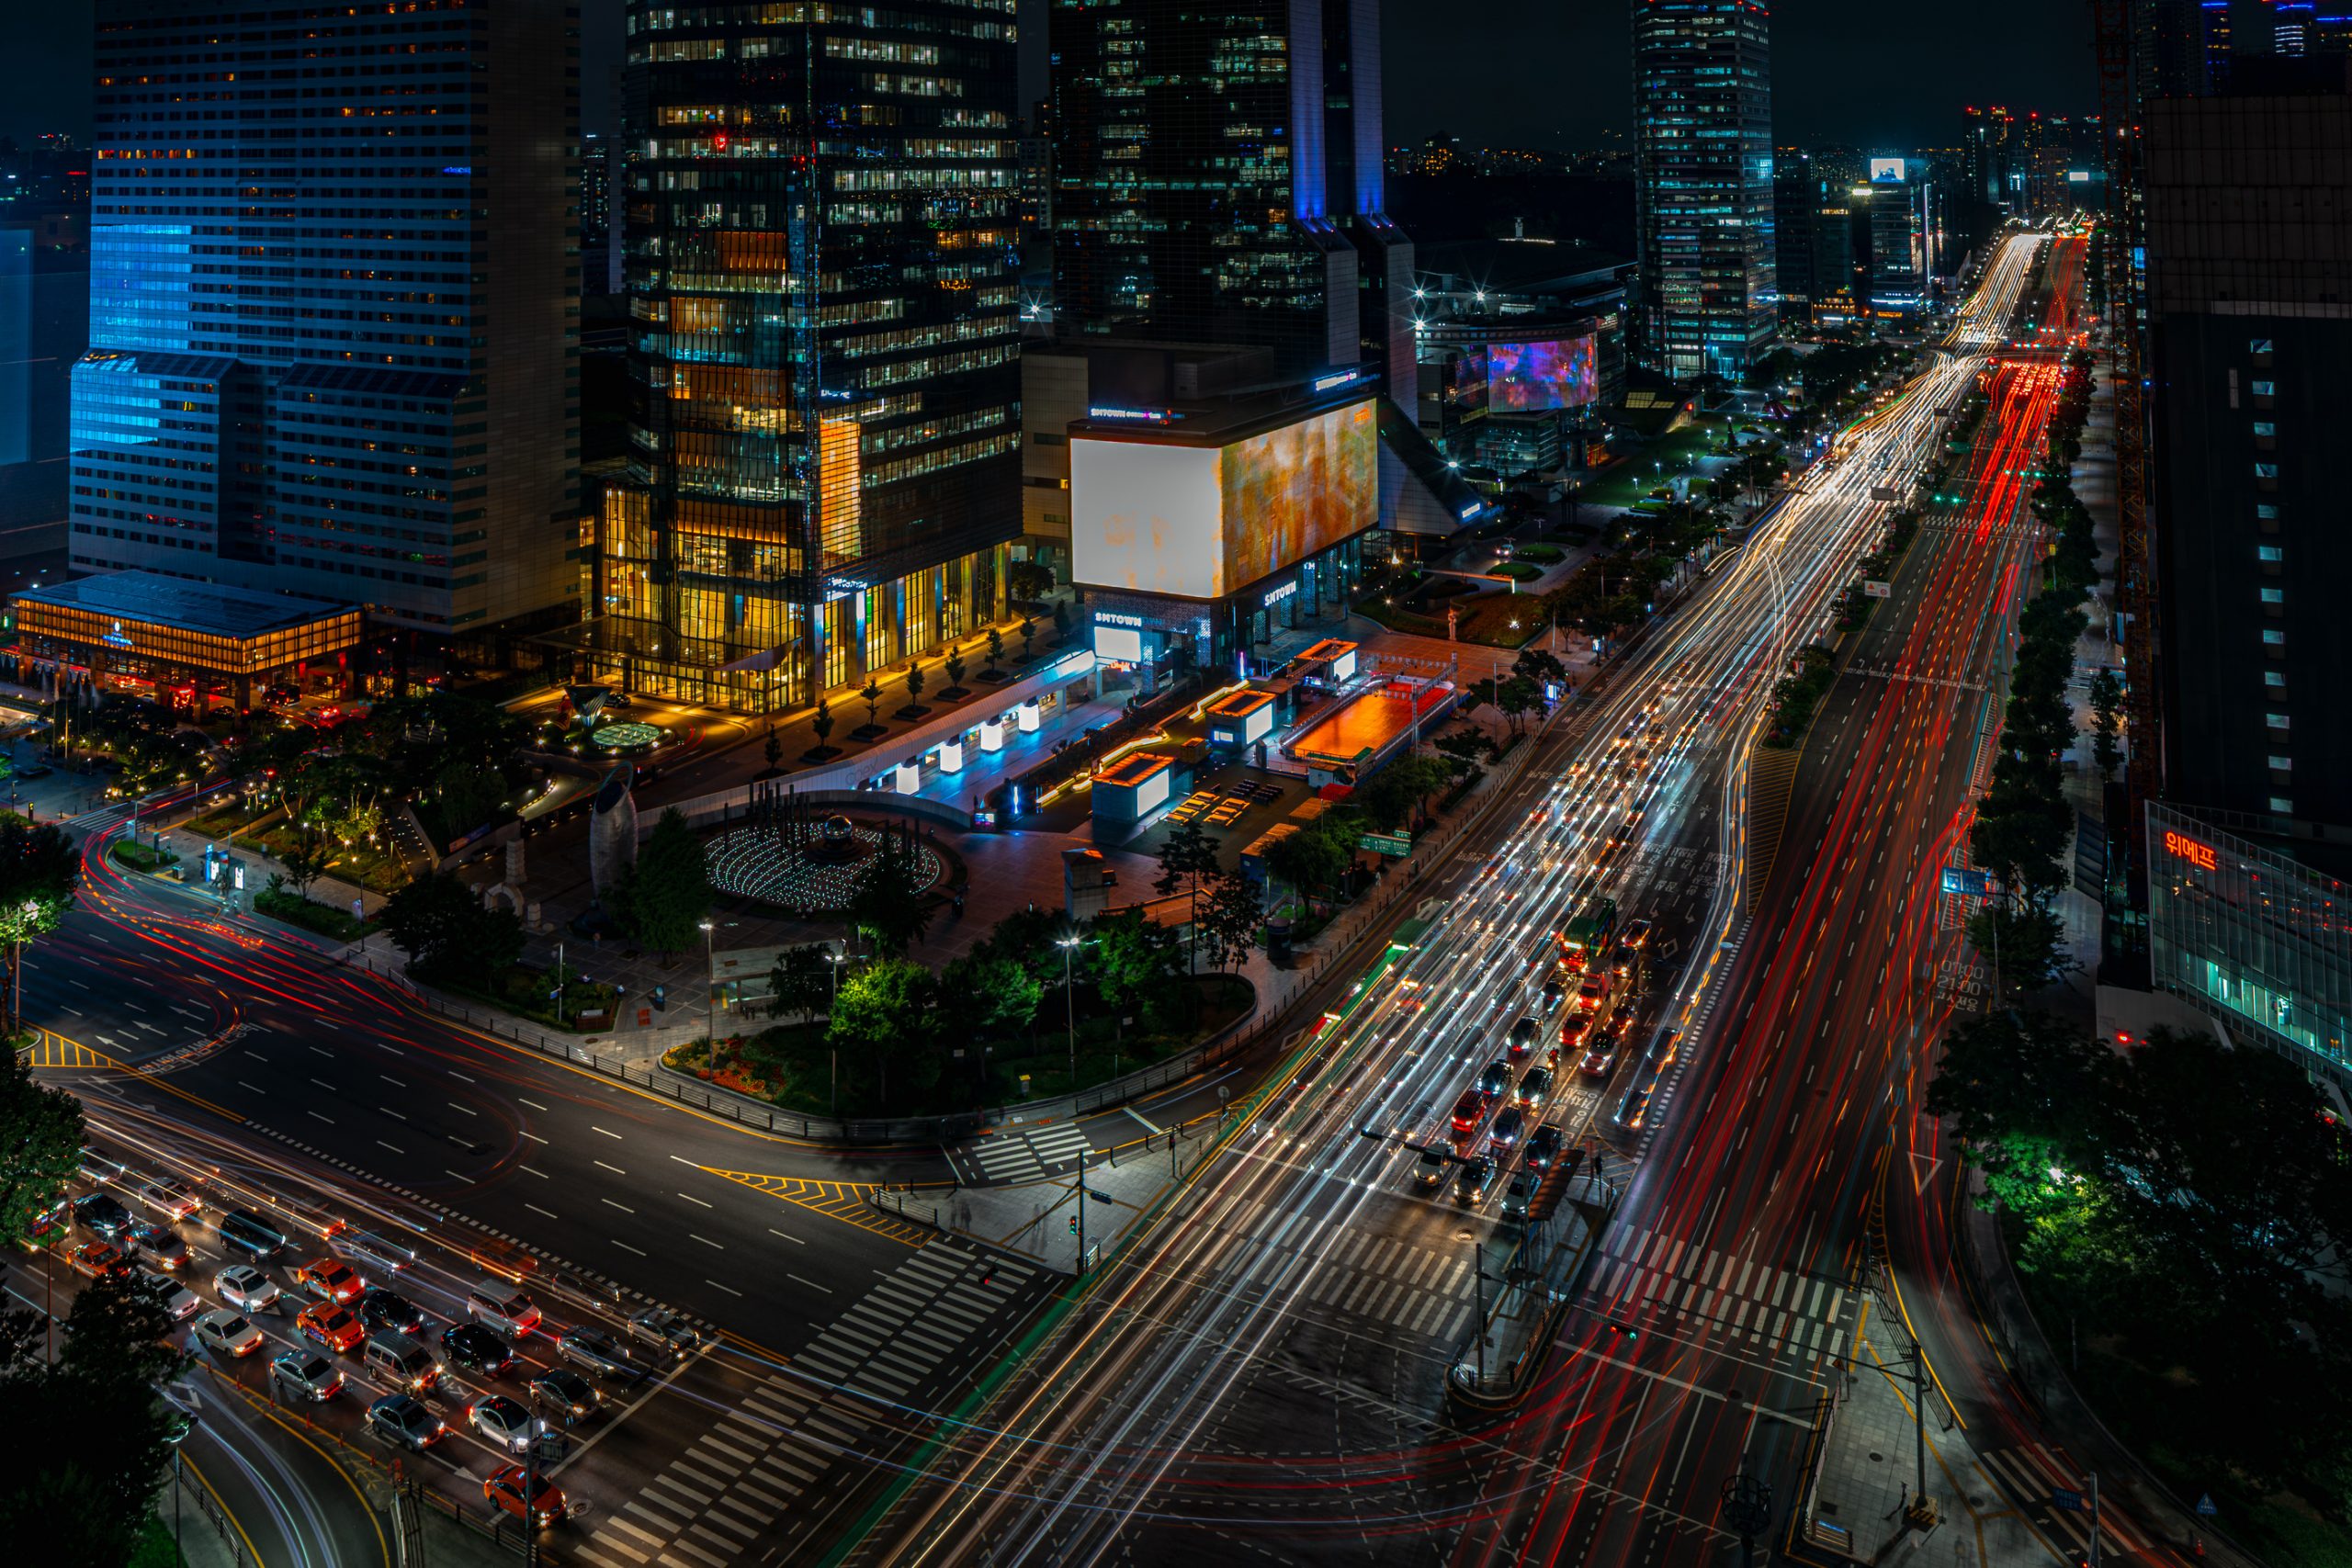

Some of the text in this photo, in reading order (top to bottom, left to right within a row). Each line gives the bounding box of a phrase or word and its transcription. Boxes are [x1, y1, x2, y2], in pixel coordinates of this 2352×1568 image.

[1264, 581, 1296, 606] SMTOWN
[1095, 612, 1142, 626] SMTOWN
[2166, 831, 2216, 870] 위메프
[1937, 975, 1981, 996] 21:00
[1560, 1087, 1598, 1111] 경찰서
